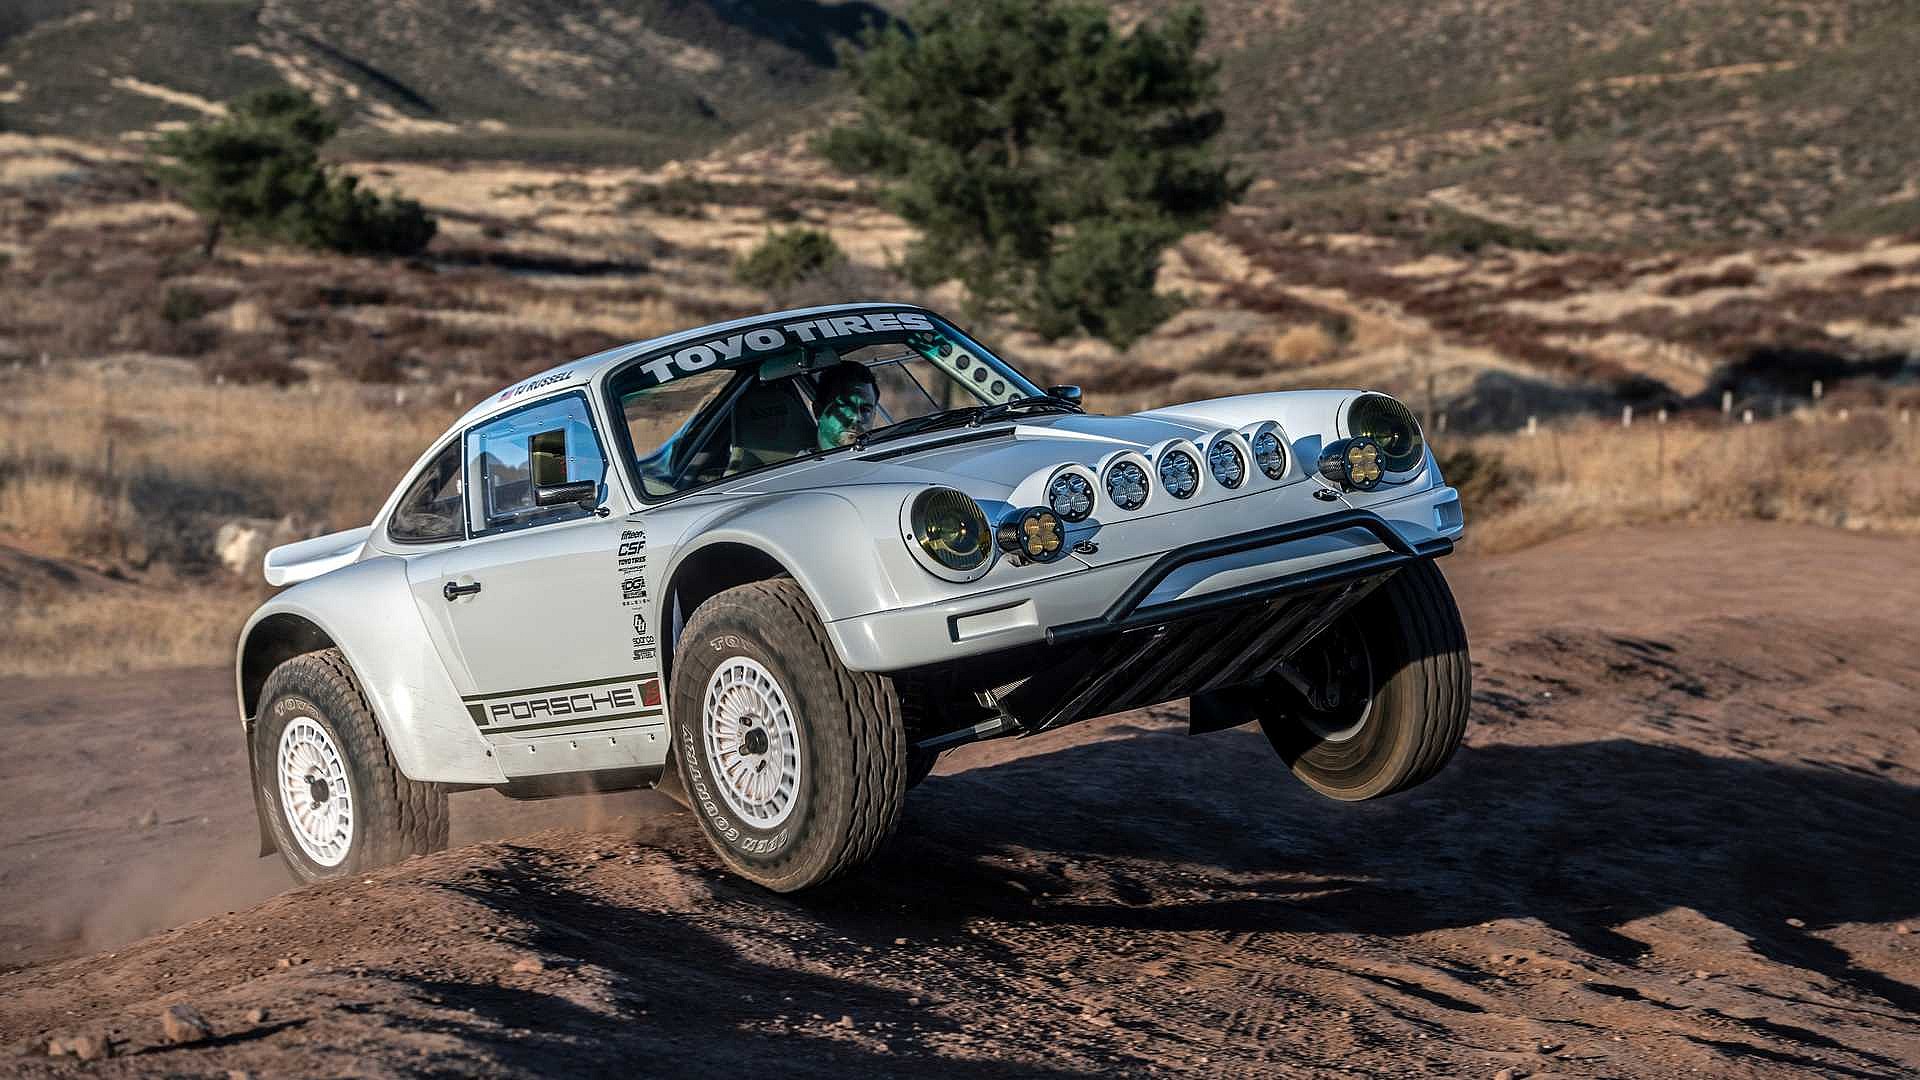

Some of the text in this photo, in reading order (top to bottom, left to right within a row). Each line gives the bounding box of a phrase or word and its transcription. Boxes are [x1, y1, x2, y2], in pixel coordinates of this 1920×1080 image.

[640, 312, 935, 383] TOYO TIRES
[512, 370, 574, 396] TJ RUSSELL
[618, 541, 646, 556] CSF
[490, 688, 636, 721] PORSCHE
